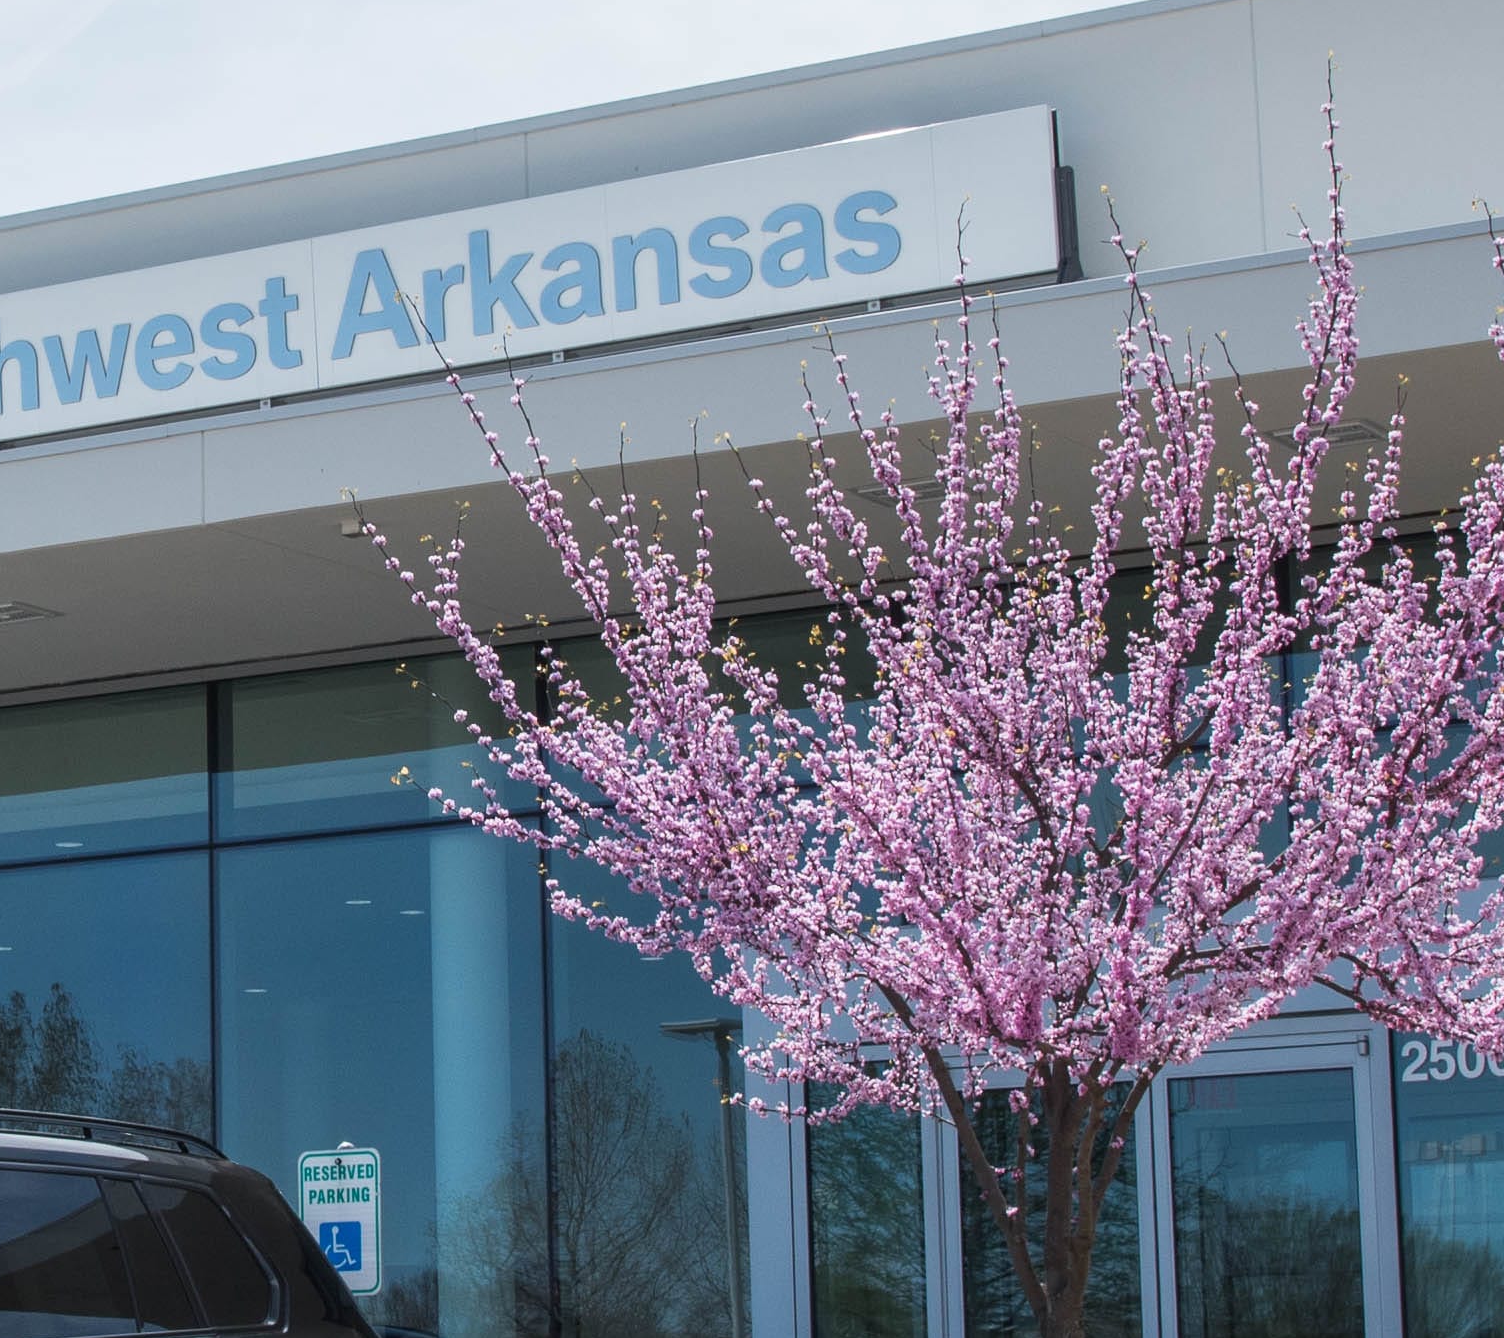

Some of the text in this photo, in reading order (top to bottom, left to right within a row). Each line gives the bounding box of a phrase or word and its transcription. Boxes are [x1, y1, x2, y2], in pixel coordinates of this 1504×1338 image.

[331, 190, 902, 360] Arkansas
[304, 1164, 374, 1181] RESERVED
[309, 1187, 370, 1204] PARKING
